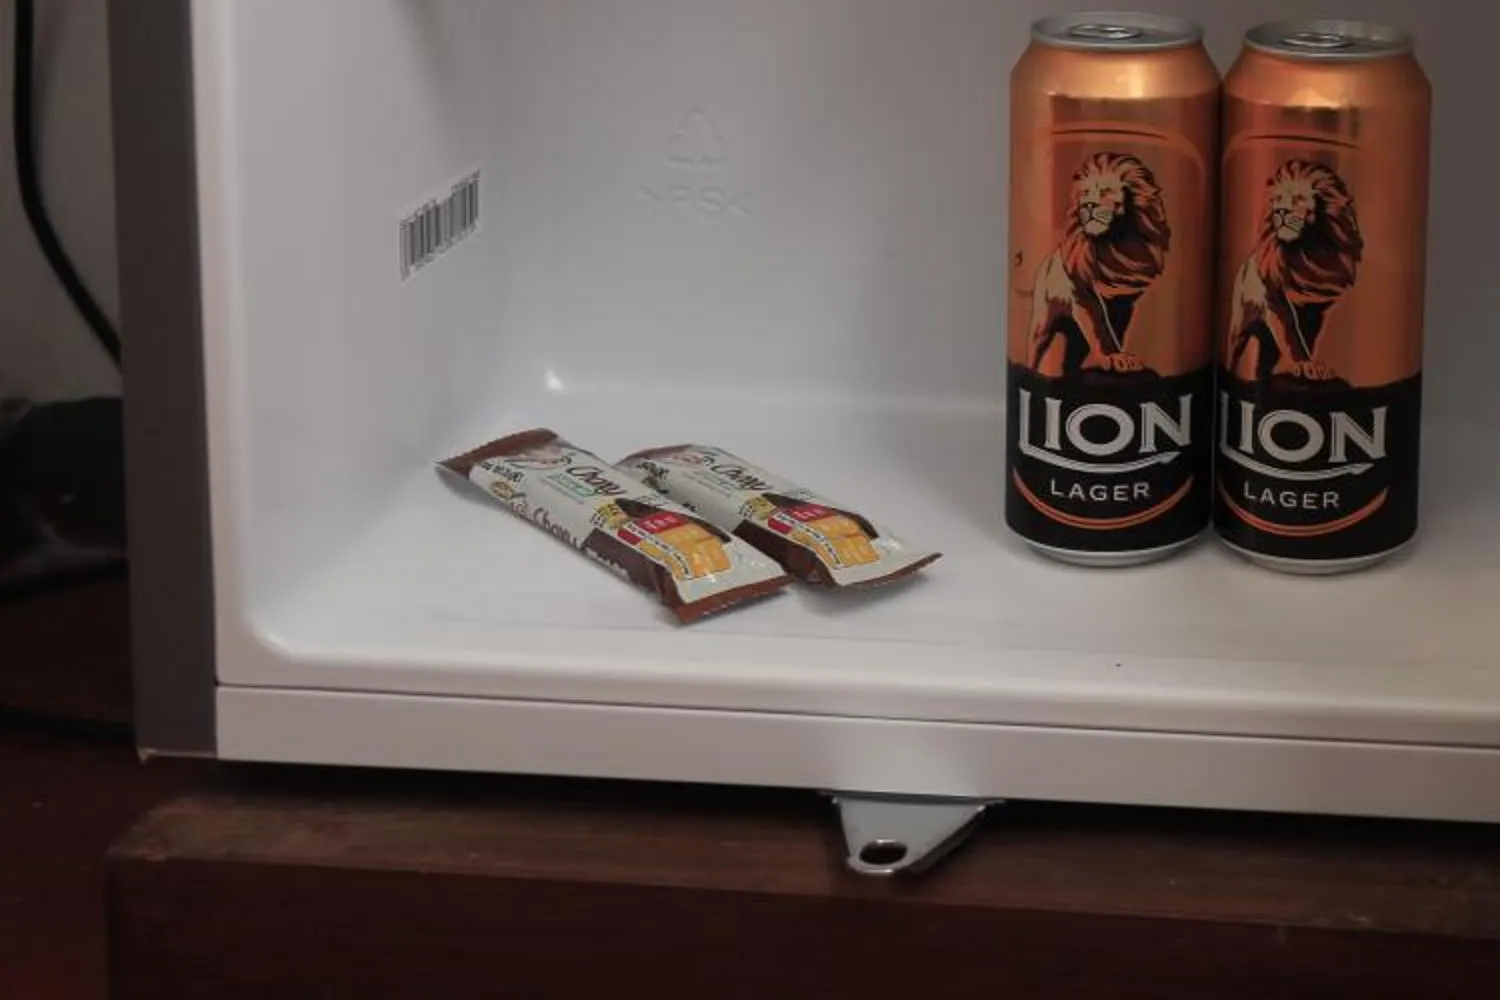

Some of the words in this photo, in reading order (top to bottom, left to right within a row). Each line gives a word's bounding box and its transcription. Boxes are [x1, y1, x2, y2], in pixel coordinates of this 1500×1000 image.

[1019, 388, 1194, 473] LION
[1219, 392, 1389, 480] LION
[1050, 478, 1151, 501] LAGER
[1243, 481, 1341, 509] LAGER
